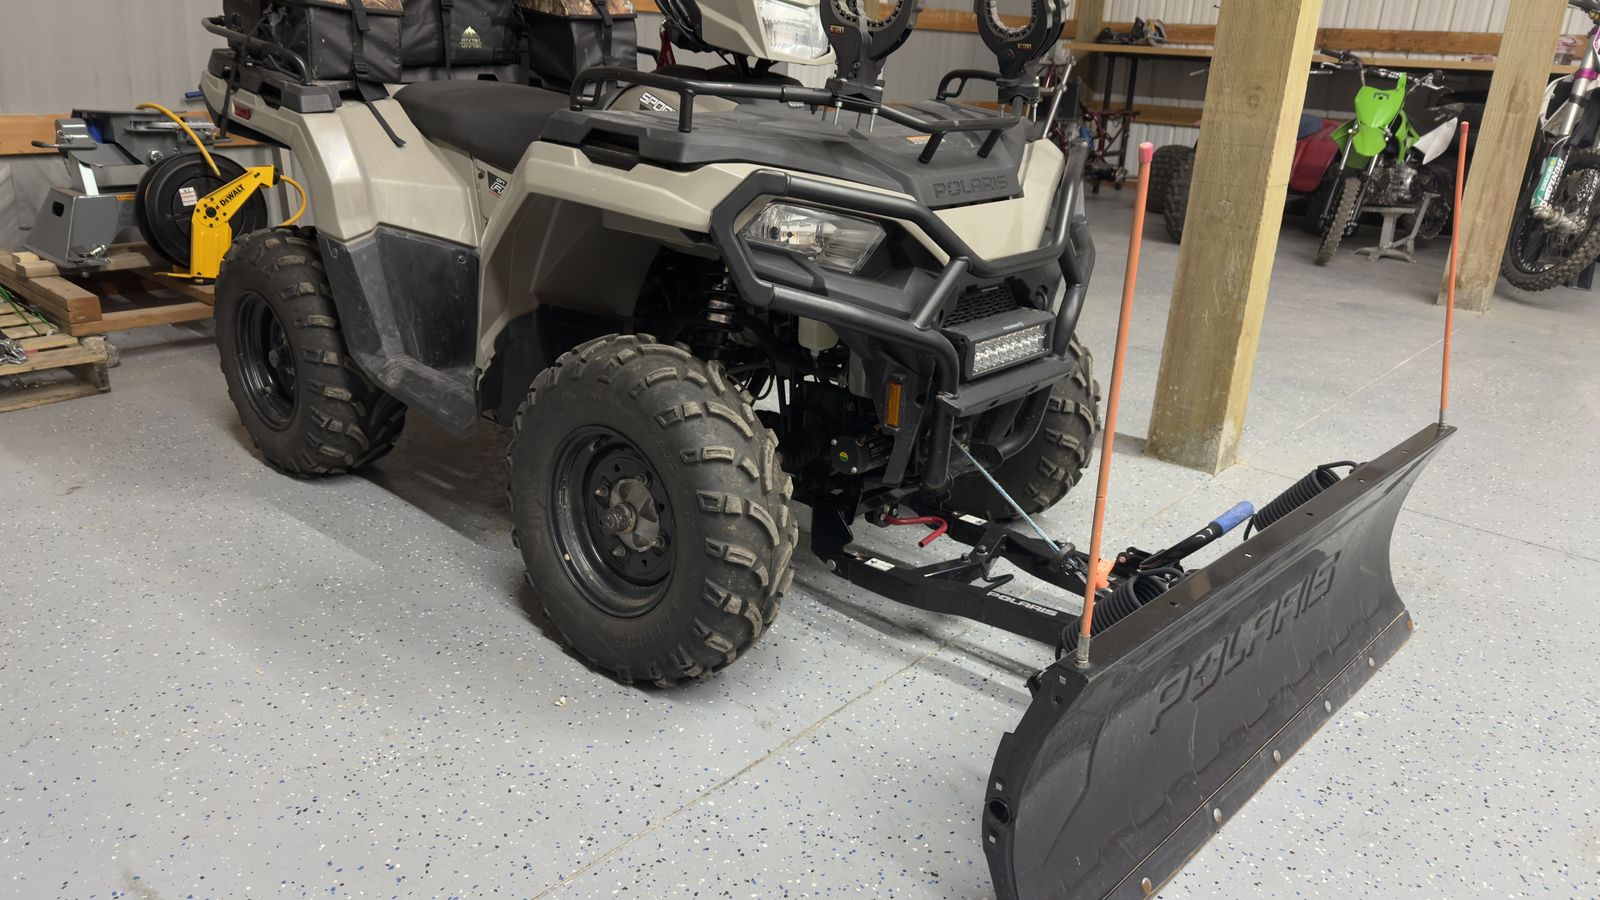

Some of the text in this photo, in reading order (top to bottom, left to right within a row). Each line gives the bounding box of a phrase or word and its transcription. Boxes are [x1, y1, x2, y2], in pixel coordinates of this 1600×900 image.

[932, 174, 1009, 199] POLARIS
[986, 591, 1059, 617] POLARIS
[1149, 550, 1342, 735] POLARIS
